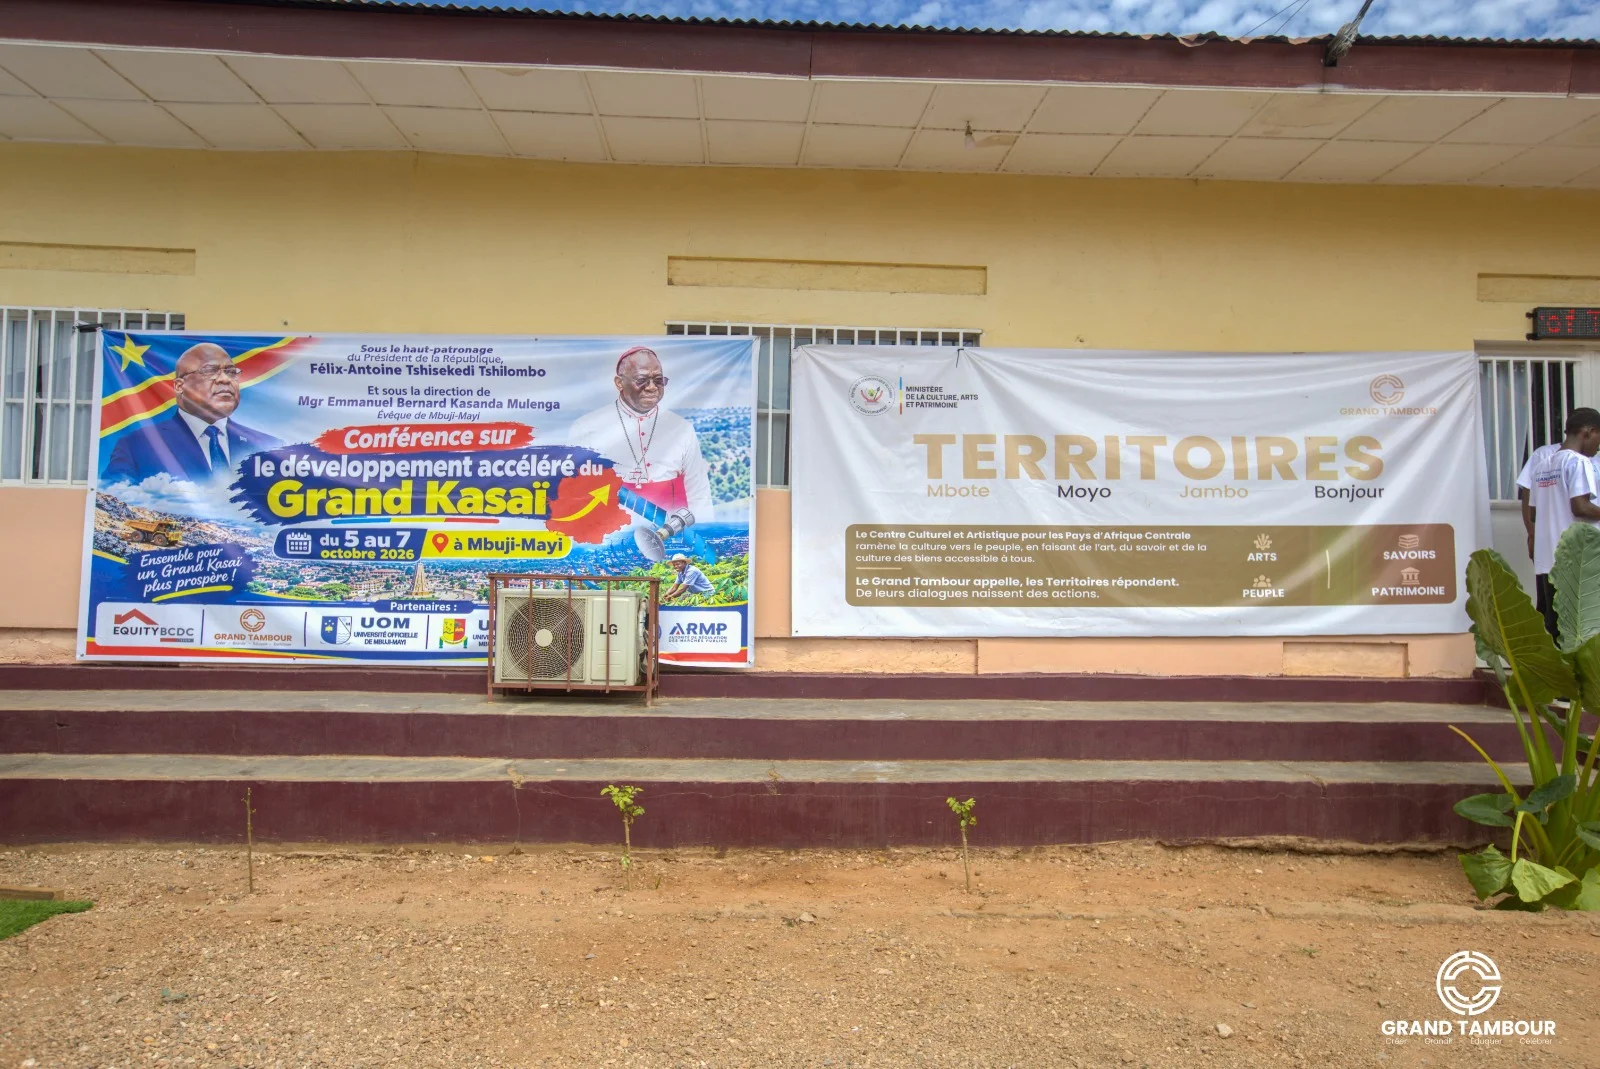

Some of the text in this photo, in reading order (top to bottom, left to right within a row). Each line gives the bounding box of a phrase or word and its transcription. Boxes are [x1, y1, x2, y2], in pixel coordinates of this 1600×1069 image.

[360, 344, 494, 355] Sous le haut-patronage
[347, 354, 504, 365] du Président de la République,
[310, 363, 546, 377] Félix-Antoine Tshisekedi Tshilombo
[368, 386, 491, 396] Et sous la direction de
[298, 396, 560, 411] Mgr Emmanuel Bernard Kasanda Mulenga
[377, 409, 480, 422] Évêque de Mbuji-Mayi
[344, 427, 516, 448] Conférence sur
[912, 433, 1384, 481] TERRITOIRES
[254, 454, 603, 482] le développement accéléré du
[926, 483, 990, 498] Mbote
[1057, 484, 1112, 502] Moyo
[1180, 484, 1249, 499] Jambo
[1314, 485, 1385, 502] Bonjour
[267, 479, 550, 518] Grand Kasaï
[320, 531, 411, 548] du 5 au 7
[855, 530, 868, 539] Le
[869, 531, 906, 539] Centre
[908, 530, 951, 539] Culturel
[966, 530, 1019, 541] Artistique
[1021, 532, 1047, 541] pour
[1048, 531, 1064, 540] les
[1065, 532, 1091, 542] Pays
[1144, 532, 1191, 540] Centrale
[454, 537, 563, 554] à Mbuji-Mayi
[855, 542, 896, 551] ramène
[911, 543, 947, 551] culture
[974, 543, 982, 551] le
[985, 543, 1023, 553] peuple,
[1041, 543, 1076, 551] faisant
[1078, 543, 1092, 551] de
[1119, 543, 1133, 551] du
[1197, 543, 1207, 551] la
[140, 547, 223, 568] Ensemble pour
[320, 548, 414, 559] octobre 2026
[855, 554, 892, 562] culture
[894, 554, 912, 562] des
[915, 554, 942, 562] biens
[944, 554, 999, 563] accessible
[1247, 552, 1277, 562] ARTS
[1383, 550, 1436, 560] SAVOIRS
[137, 556, 243, 580] un Grand Kasaï
[143, 568, 237, 597] plus prospère !
[856, 576, 1180, 589] Le Grand Tambour appelle, les Territoires répondent.
[856, 588, 1100, 600] De leurs dialogues naissent des actions.
[1242, 588, 1285, 598] PEUPLE
[1372, 587, 1445, 596] PATRIMOINE
[390, 602, 450, 612] Partenaires
[361, 617, 410, 629] UOM
[599, 623, 618, 635] LG
[669, 623, 728, 635] ARMP
